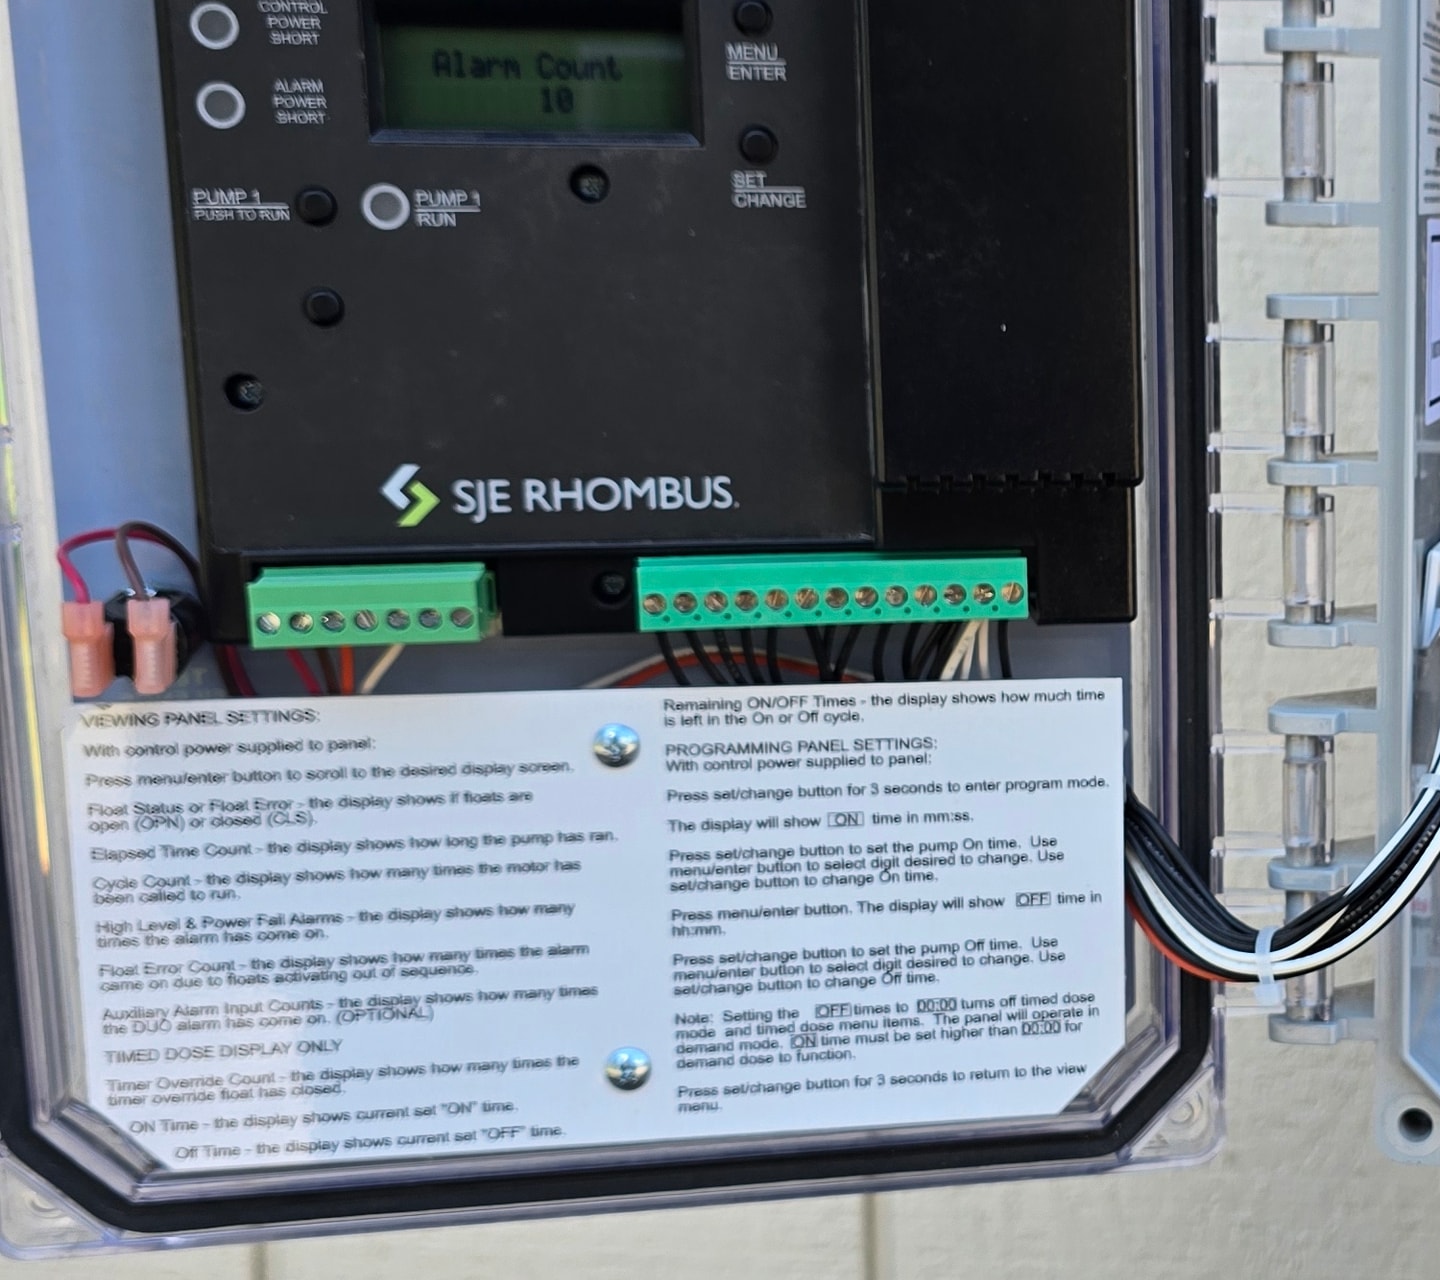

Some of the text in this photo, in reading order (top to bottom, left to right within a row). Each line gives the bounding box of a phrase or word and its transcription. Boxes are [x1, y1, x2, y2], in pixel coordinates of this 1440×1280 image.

[267, 16, 321, 30] POWER
[270, 31, 320, 45] SHORT
[726, 42, 778, 61] MENU
[432, 48, 623, 81] Alarm Count
[726, 65, 787, 81] ENTER
[274, 78, 324, 93] ALARM
[273, 94, 327, 108] POWER
[540, 86, 574, 113] 10
[275, 111, 326, 124] SHORT
[732, 171, 767, 188] SET
[192, 188, 261, 204] PUMP 1
[414, 189, 481, 206] PUMP 1
[732, 193, 807, 208] CHANGE
[194, 210, 290, 221] PUSH TO RUN
[415, 212, 457, 227] RUN
[452, 475, 734, 524] SJE RHOMBUS
[663, 696, 742, 711] Remaining
[746, 694, 808, 709] ON/OFF
[813, 694, 856, 706] Times
[871, 693, 893, 705] the
[897, 692, 947, 706] display
[951, 691, 996, 703] shows
[1001, 690, 1030, 702] how
[1034, 689, 1072, 702] much
[1076, 689, 1106, 701] time
[663, 711, 864, 726] is left in the On or Off cycle.
[665, 737, 937, 755] PROGRAMMING PANEL SETTINGS:
[665, 753, 931, 770] With control power supplied to panel:
[666, 776, 1109, 801] Press set/change button for 3 seconds to enter program mode.
[668, 811, 973, 832] The display will show ON time in mm:ss.
[668, 836, 1058, 860] Press set/change button to set the pump On time. Use
